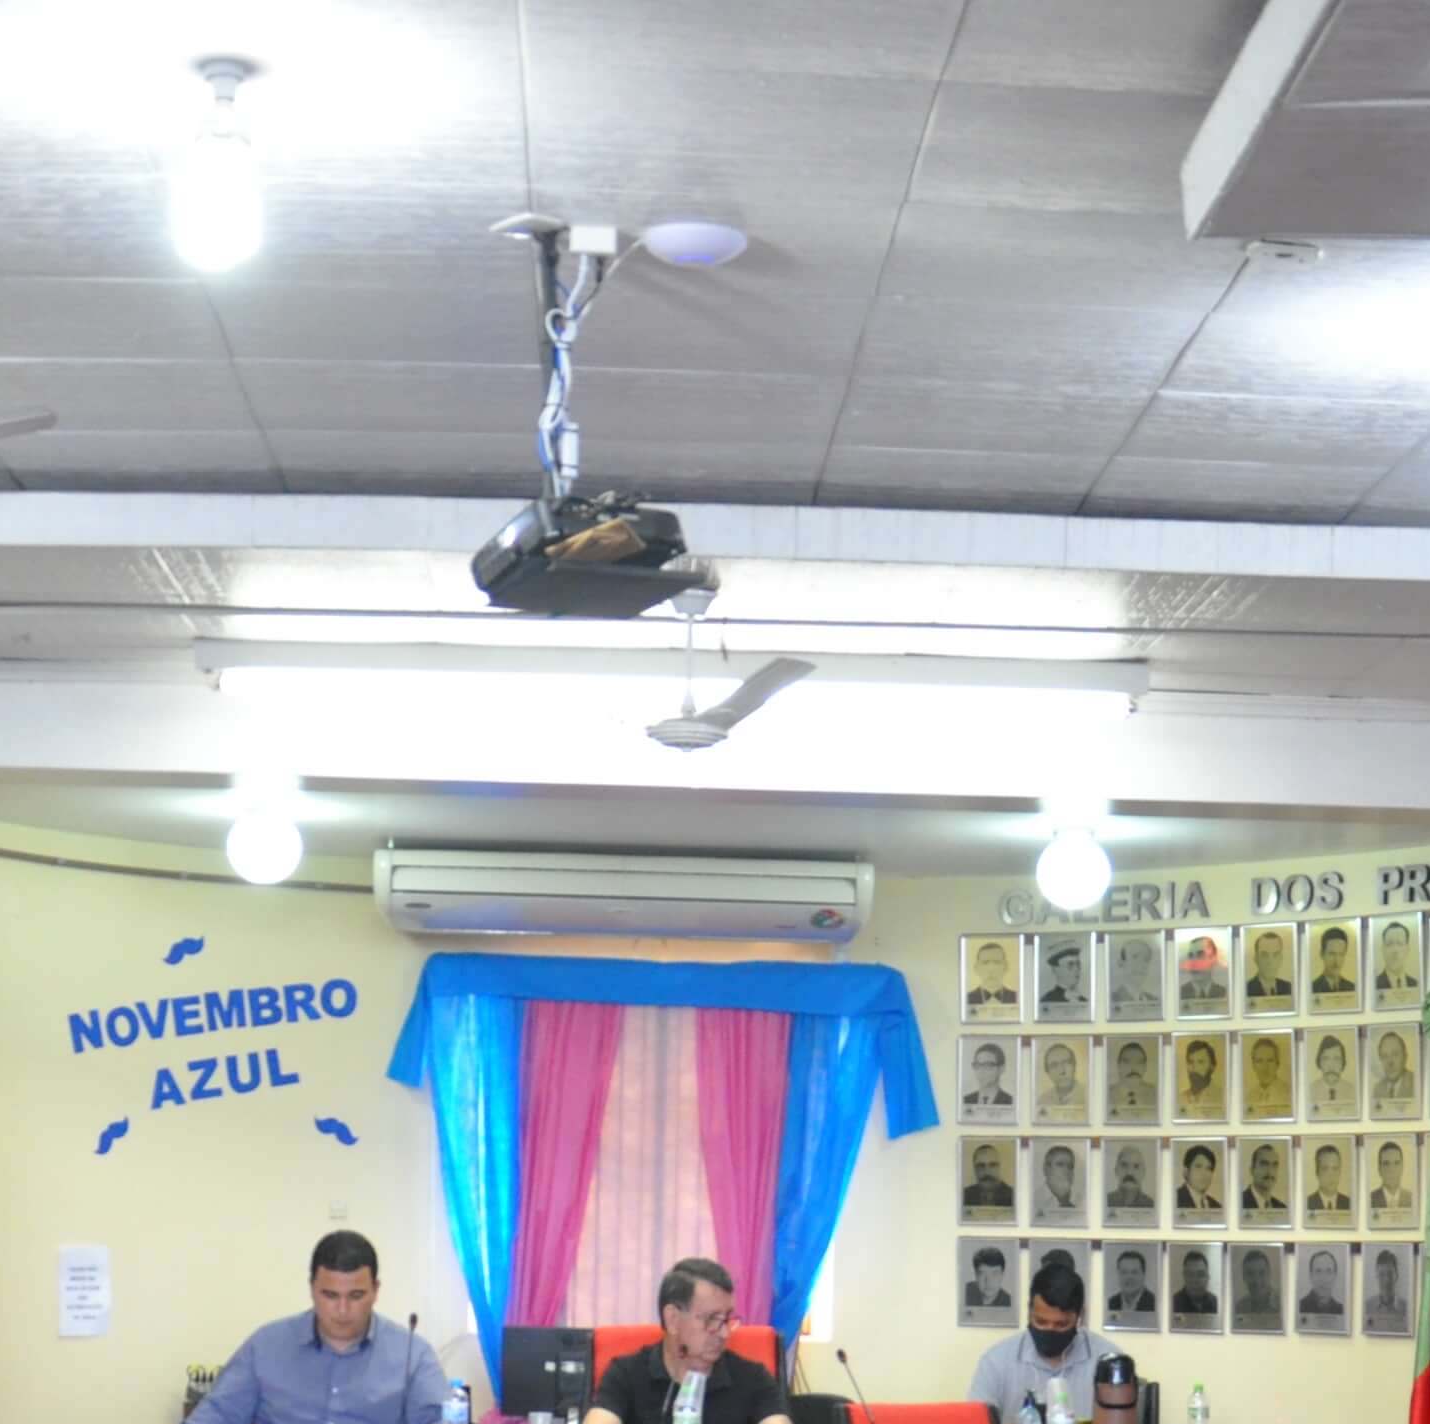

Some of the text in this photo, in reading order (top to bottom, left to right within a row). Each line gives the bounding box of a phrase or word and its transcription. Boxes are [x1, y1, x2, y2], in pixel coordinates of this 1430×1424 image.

[1250, 871, 1345, 916] DOS
[67, 978, 359, 1054] NOVEMBRO
[150, 1048, 300, 1111] AZUL
